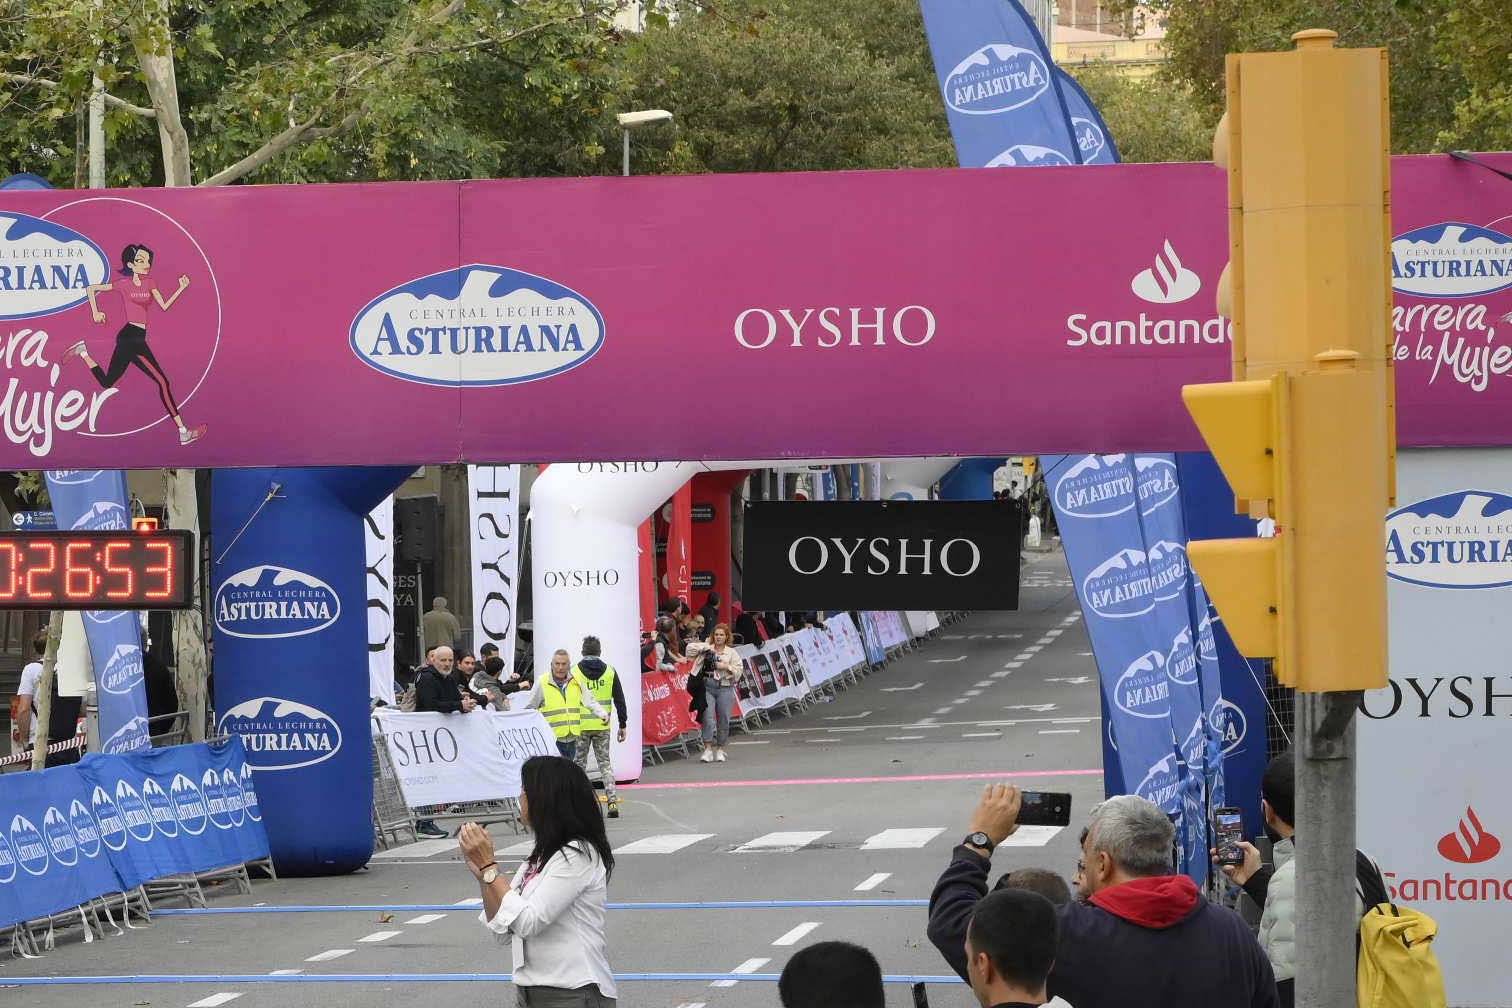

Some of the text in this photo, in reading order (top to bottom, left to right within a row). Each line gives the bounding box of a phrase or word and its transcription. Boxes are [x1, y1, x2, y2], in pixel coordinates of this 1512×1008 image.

[12, 247, 86, 259] LECHERA
[1406, 248, 1457, 257] CENTRAL
[408, 305, 578, 321] CENTRAL LECHERA
[734, 305, 937, 349] OYSHO
[1392, 303, 1487, 333] arrera
[369, 311, 586, 357] ASTURIANA
[1067, 312, 1232, 347] Santan
[1415, 333, 1433, 361] la
[1429, 327, 1512, 392] Muje
[1412, 525, 1480, 535] CENTRAL
[476, 464, 511, 641] OYSH
[787, 535, 981, 577] OYSHO
[1386, 528, 1512, 565] ASTURIA
[544, 568, 620, 589] OYSHO
[231, 589, 327, 599] CENTRAL LECHERA
[218, 598, 331, 623] ASTURIANA
[1357, 676, 1512, 719] OYSH
[232, 720, 327, 731] CENTRAL LECHERA
[234, 732, 332, 753] TURIANA
[392, 726, 459, 767] SHO
[1386, 874, 1512, 901] Santan
